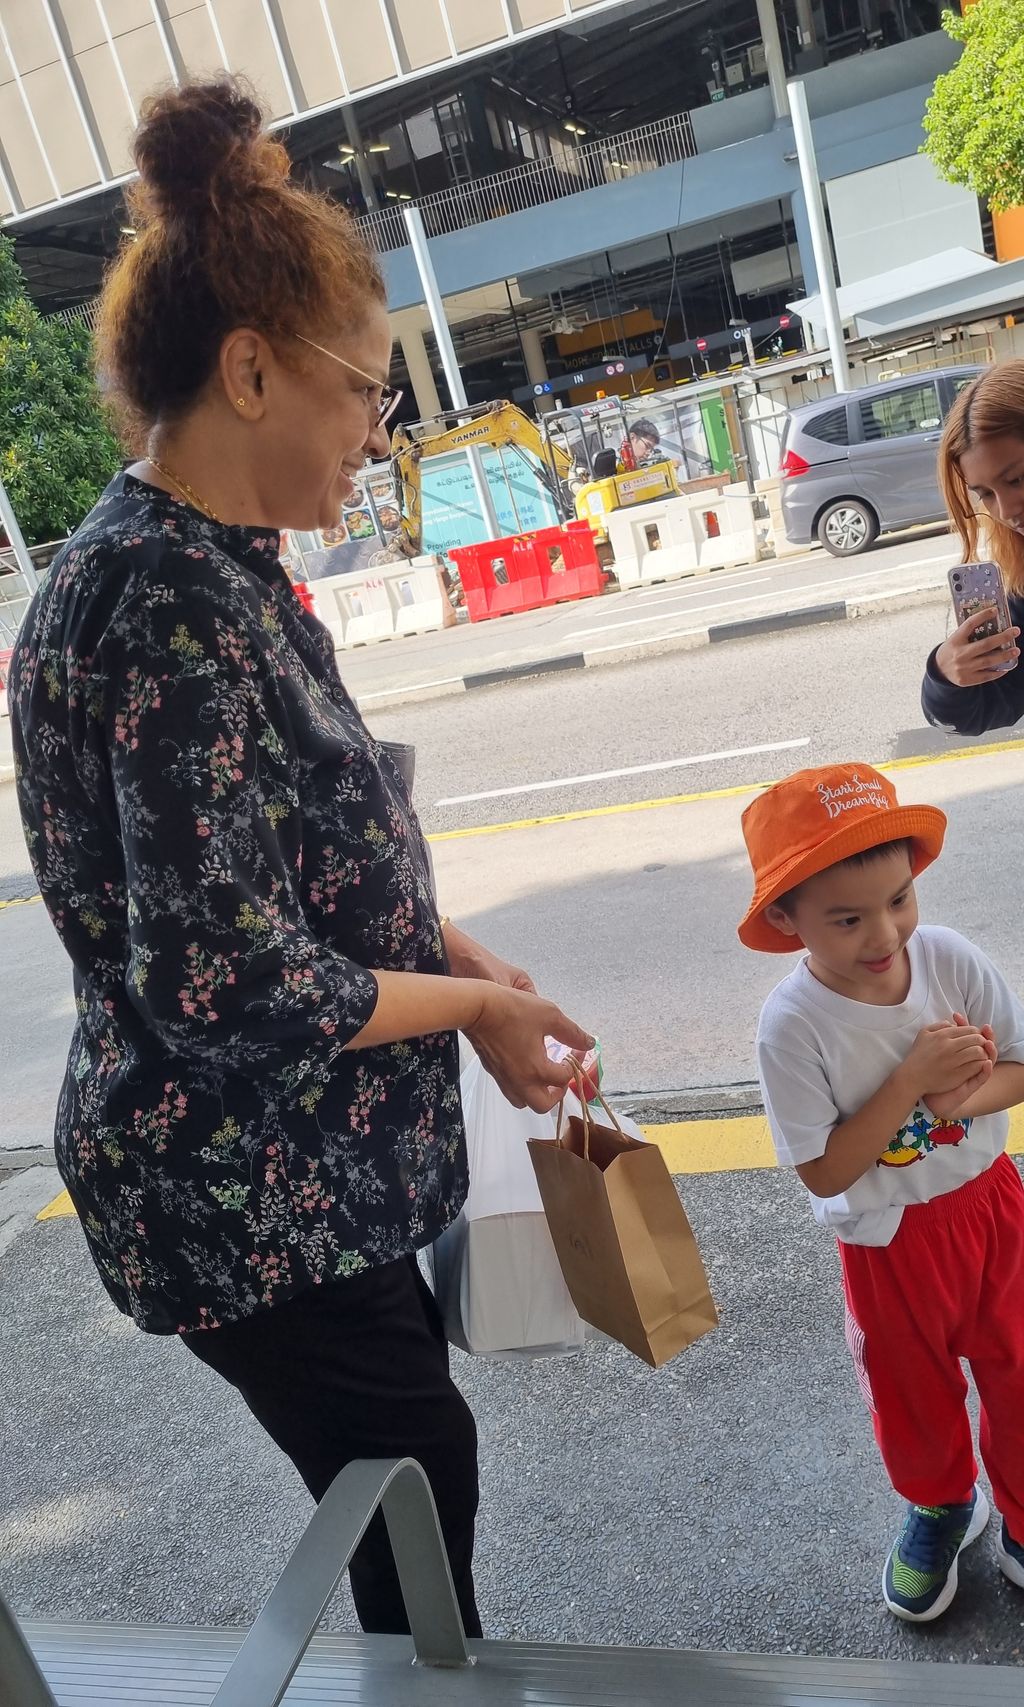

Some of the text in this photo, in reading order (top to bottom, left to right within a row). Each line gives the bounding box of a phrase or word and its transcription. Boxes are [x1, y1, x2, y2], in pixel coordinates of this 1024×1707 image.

[573, 373, 584, 385] IN
[450, 426, 490, 444] YANMAR
[426, 538, 462, 551] Providing
[817, 774, 882, 804] Start Small
[825, 792, 890, 818] Dream Big
